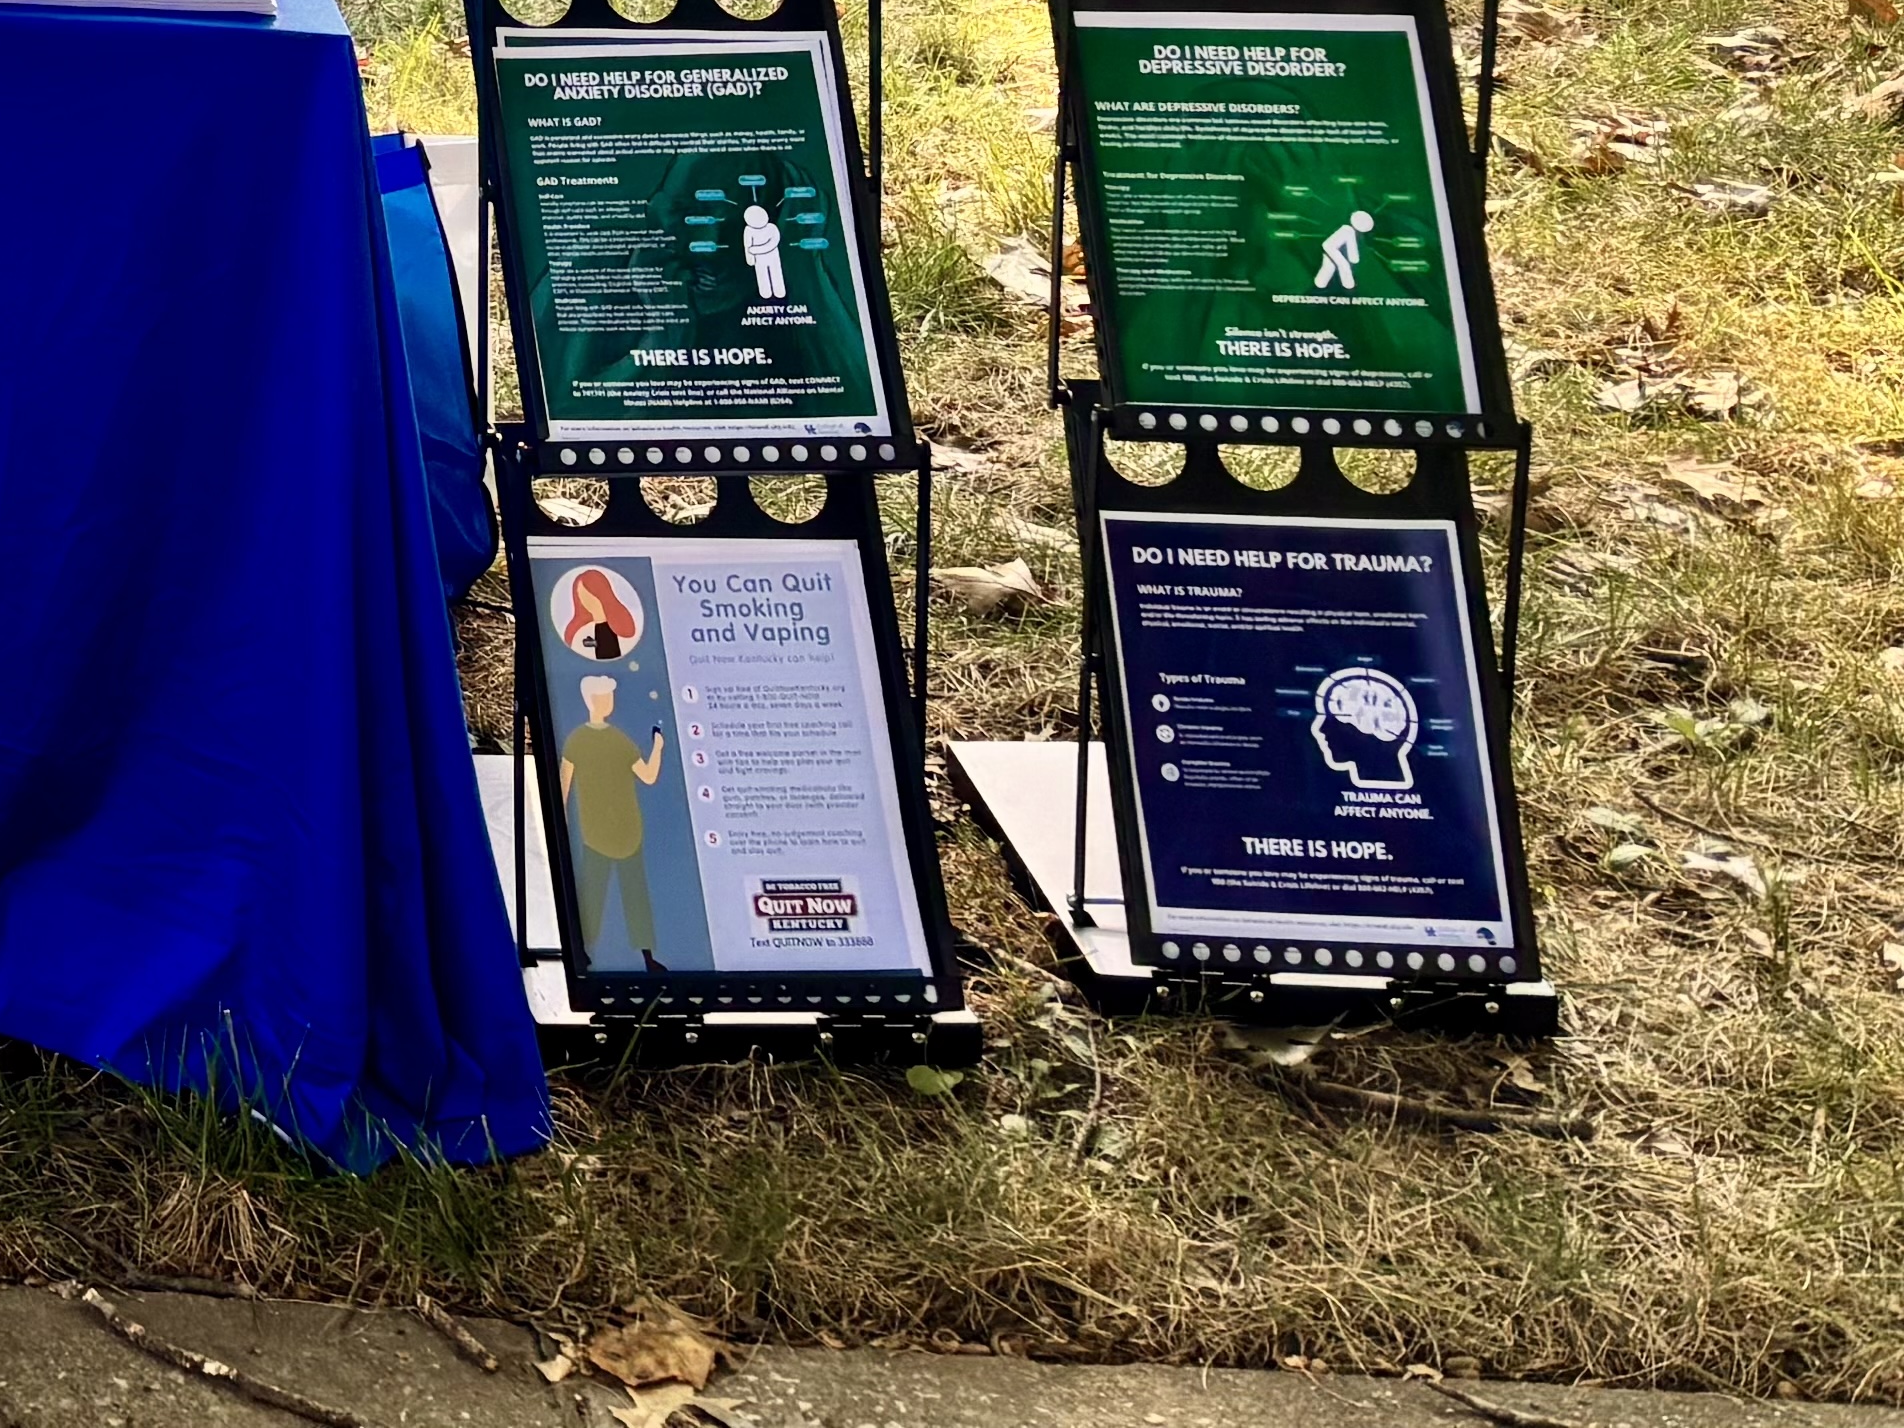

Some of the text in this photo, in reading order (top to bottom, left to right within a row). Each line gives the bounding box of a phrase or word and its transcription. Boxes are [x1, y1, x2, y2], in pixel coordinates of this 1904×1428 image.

[1154, 45, 1327, 62] DO I NEED HELP FOR
[524, 67, 788, 87] DO I NEED HELP FOR GENERALIZED
[1139, 59, 1346, 77] DEPRESSIVE DISORDER?
[554, 82, 762, 100] ANXIETY DISORDER (GAD)?
[1132, 547, 1433, 573] DO I NEED HELP FOR TRAUMA?
[672, 572, 832, 594] You Can Quit
[701, 597, 804, 621] Smoking
[692, 622, 830, 646] and Vaping
[758, 897, 852, 915] QUIT NOW
